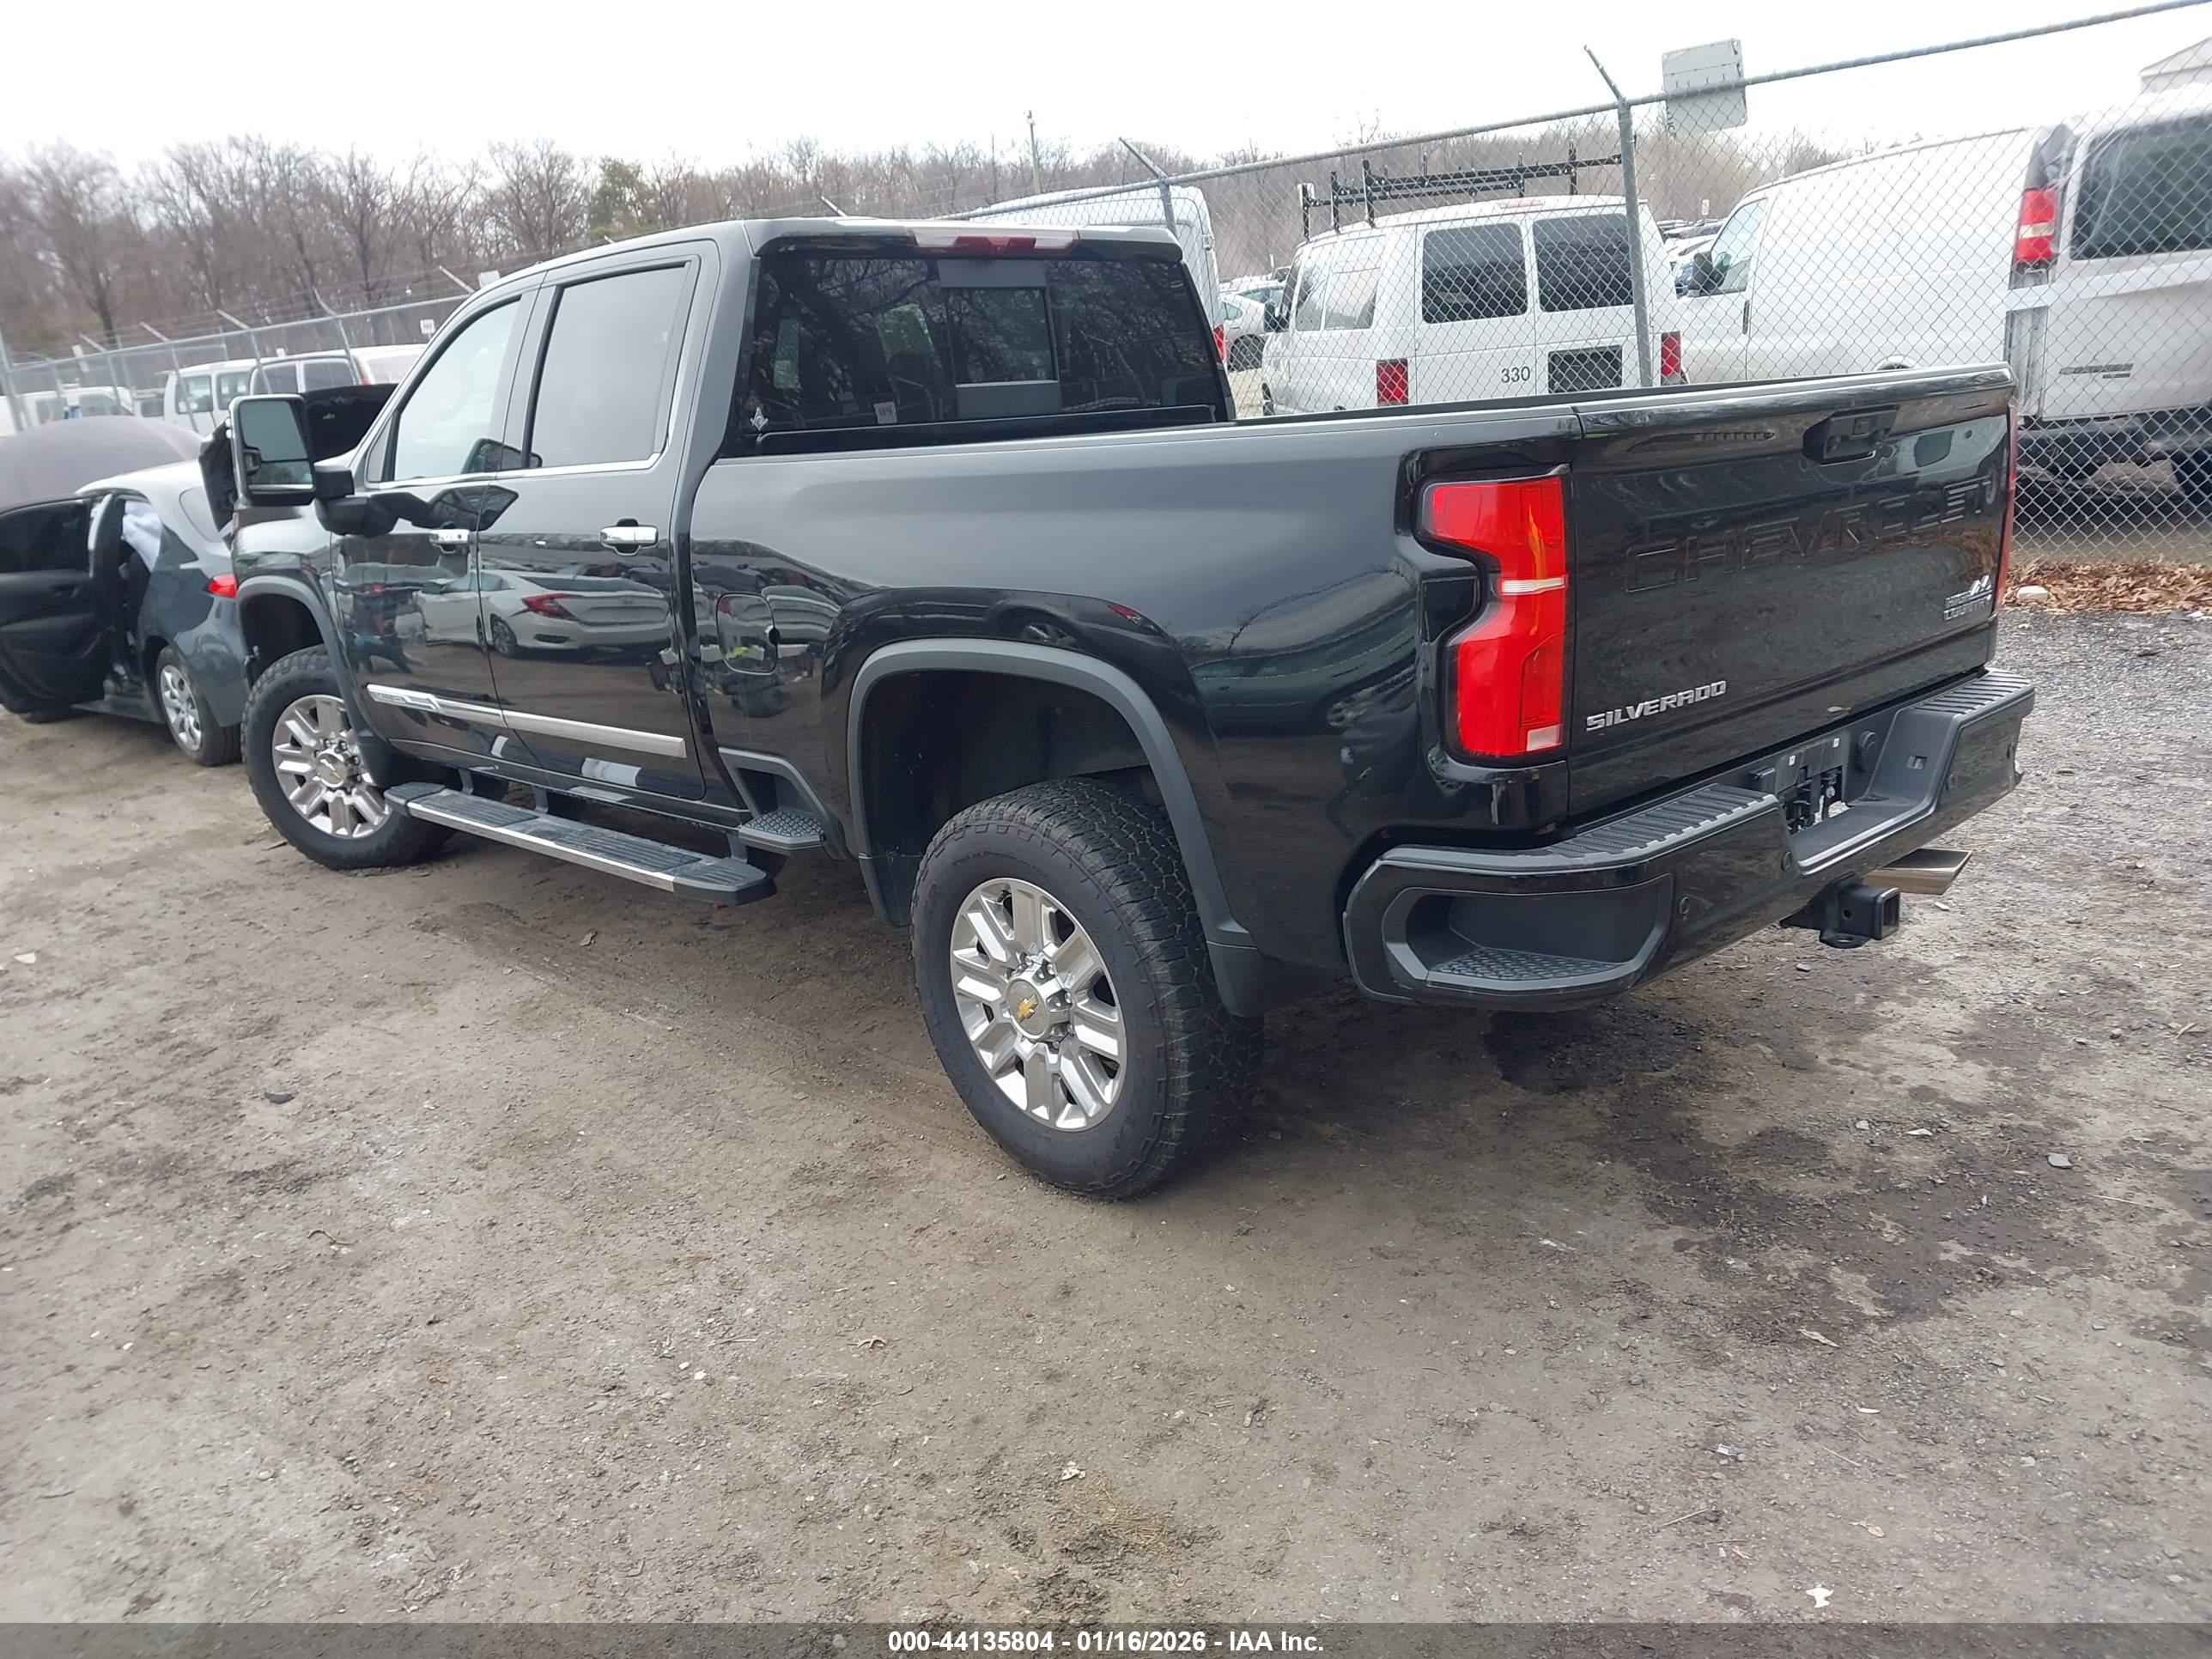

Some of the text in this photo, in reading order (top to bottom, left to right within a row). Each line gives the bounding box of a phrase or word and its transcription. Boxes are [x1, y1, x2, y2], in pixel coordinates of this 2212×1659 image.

[1501, 366, 1531, 384] 330
[1625, 474, 1992, 594] CHEVROLET
[1586, 680, 1727, 732] SILVERADO
